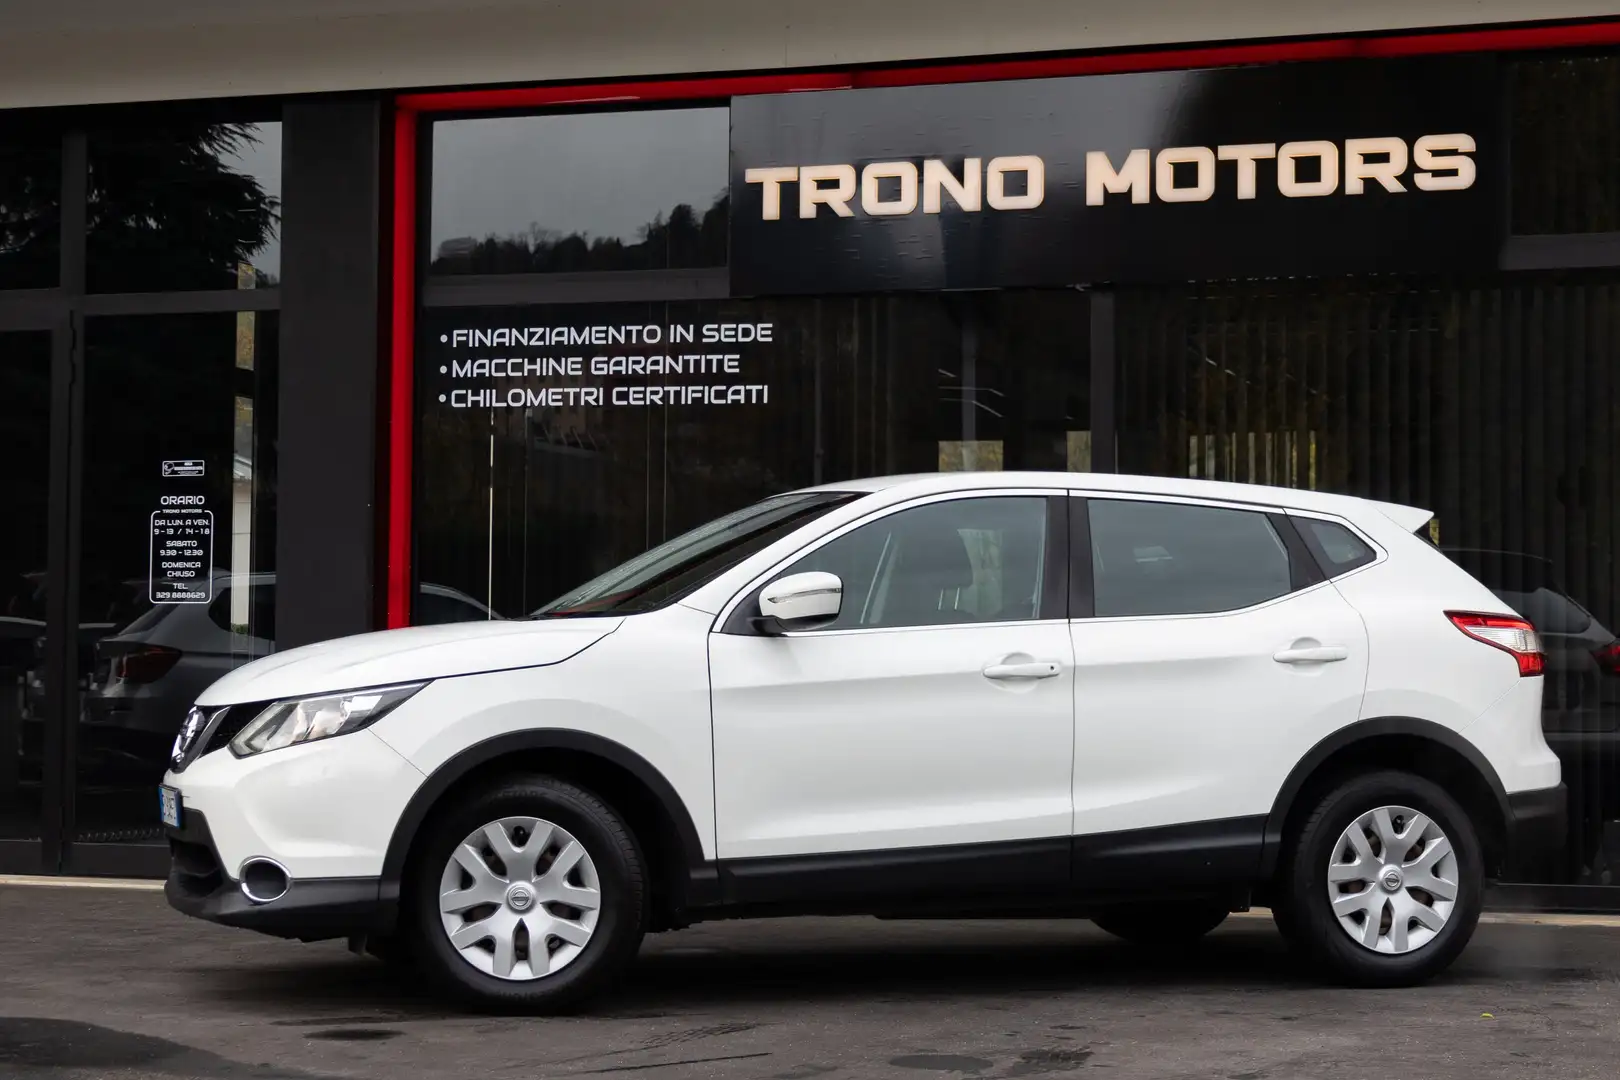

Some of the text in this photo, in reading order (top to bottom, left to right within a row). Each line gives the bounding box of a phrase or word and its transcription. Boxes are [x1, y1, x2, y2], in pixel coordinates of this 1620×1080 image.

[744, 132, 1477, 221] TRONO MOTORS
[452, 323, 773, 348] FINANZIAMENTO IN SEDE
[452, 354, 740, 378] MACCHINE GARANTITE
[450, 385, 768, 408] CHILOMETRI CERTIFICATI
[160, 495, 205, 505] ORARIO
[161, 561, 201, 569] DOMENICA
[167, 570, 196, 578] CHIUSO
